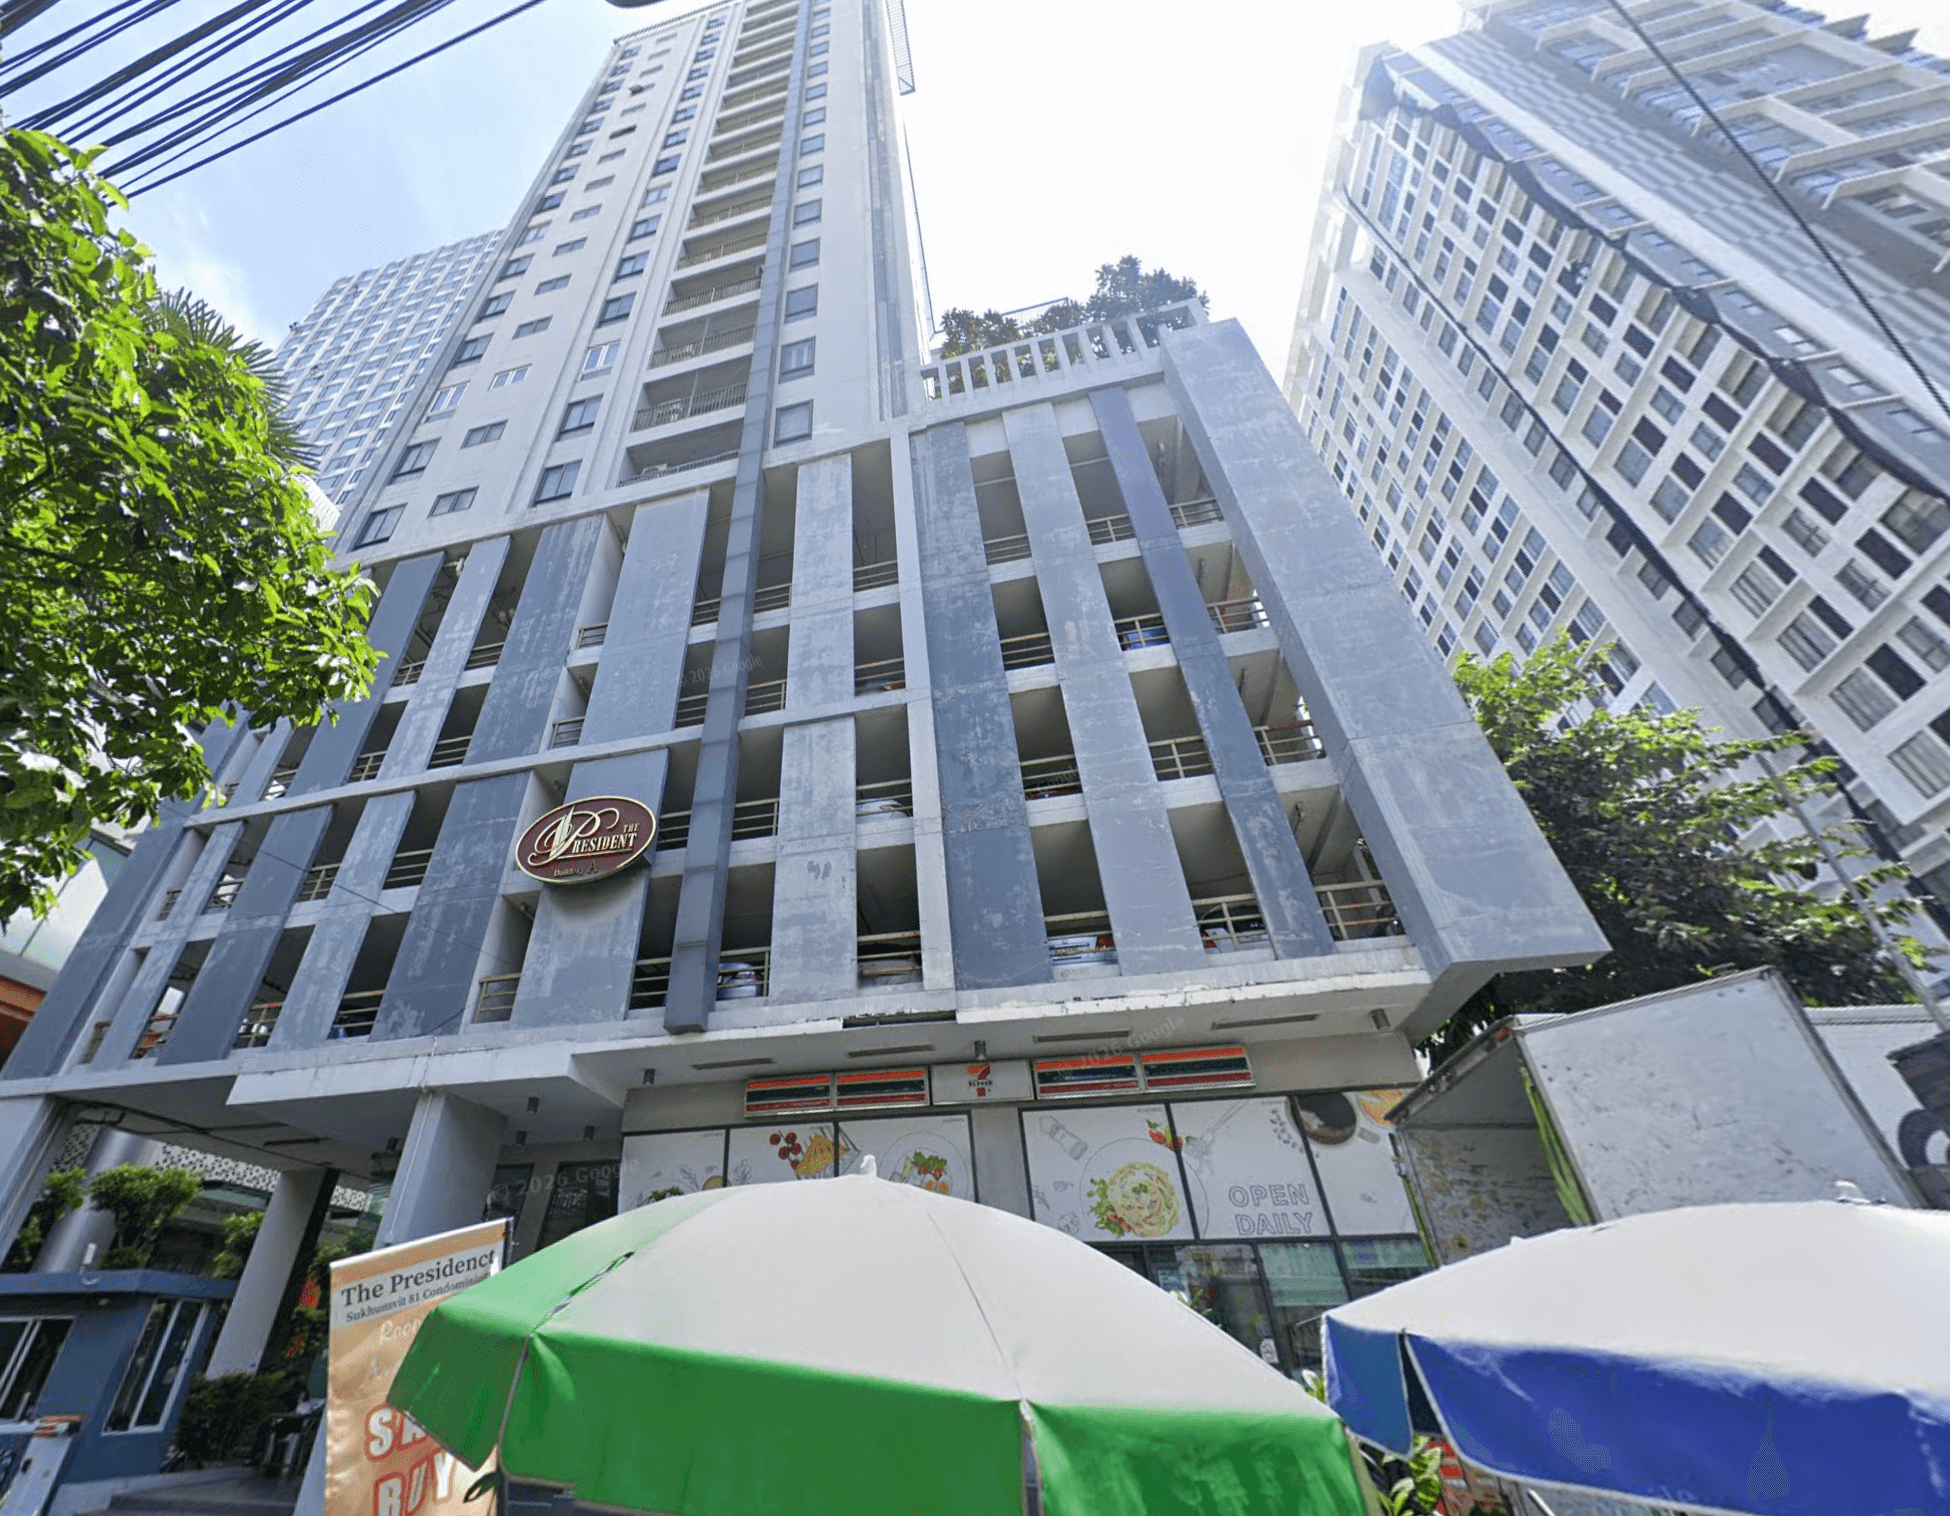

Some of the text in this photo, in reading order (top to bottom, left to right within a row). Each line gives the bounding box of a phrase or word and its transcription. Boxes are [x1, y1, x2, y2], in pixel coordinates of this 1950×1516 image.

[623, 822, 640, 833] THE
[587, 859, 598, 875] A
[1228, 1184, 1310, 1208] OPEN
[1234, 1212, 1313, 1236] DAILY
[341, 1282, 384, 1308] The
